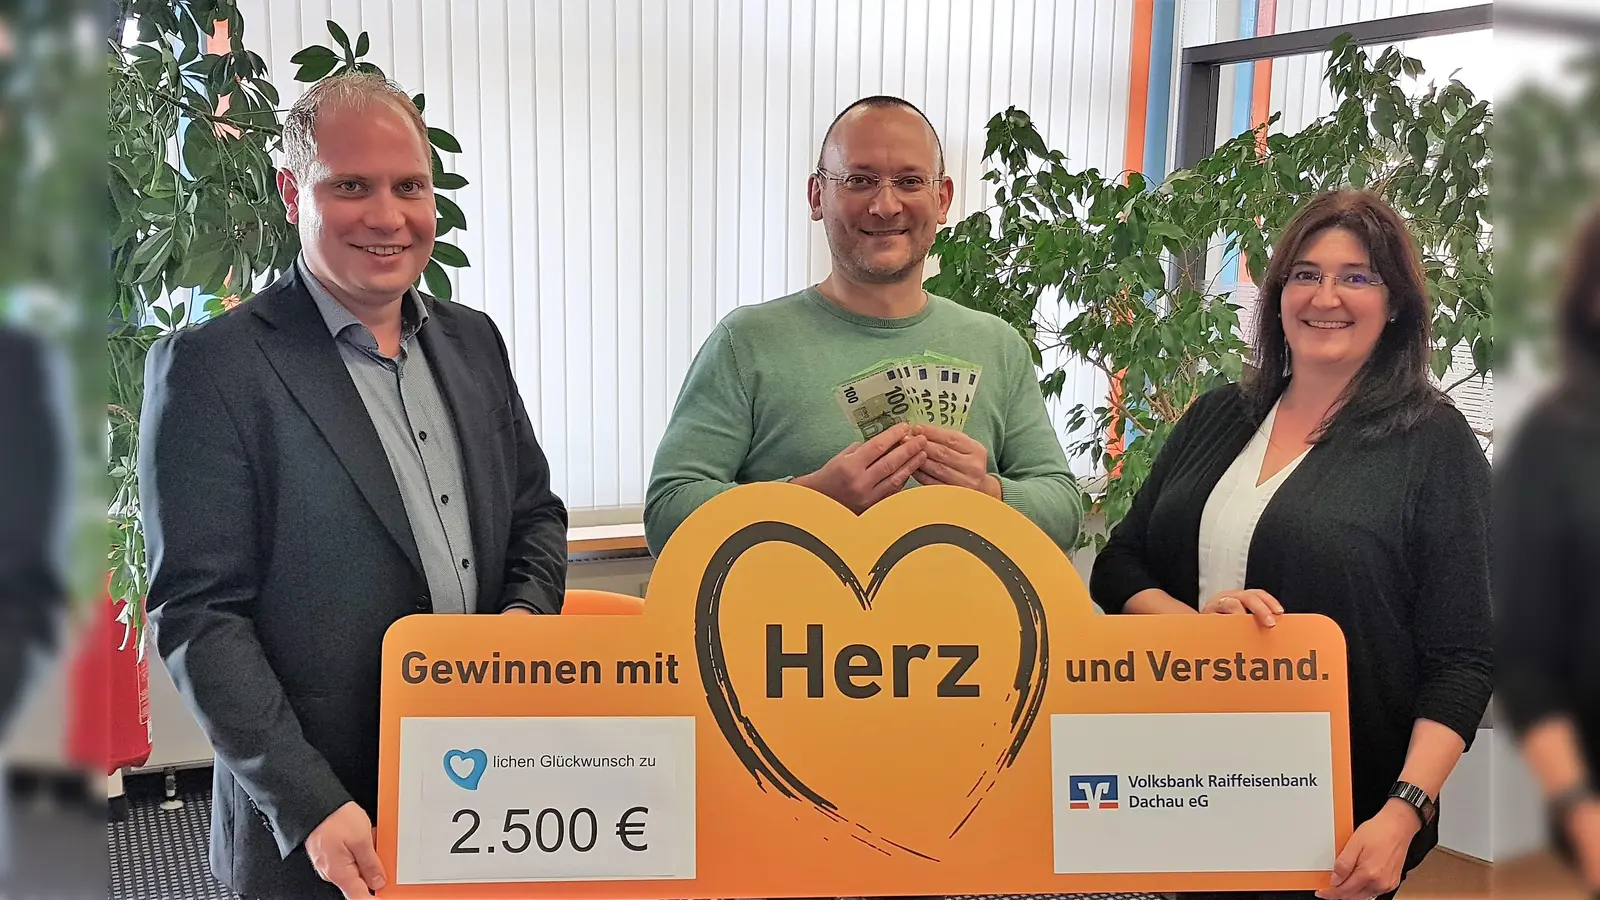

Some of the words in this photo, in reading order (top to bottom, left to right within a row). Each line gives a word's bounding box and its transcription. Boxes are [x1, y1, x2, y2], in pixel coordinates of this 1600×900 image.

[843, 386, 859, 404] 100
[884, 385, 909, 415] 100
[401, 651, 602, 685] Gewinnen
[616, 652, 680, 685] mit
[765, 623, 981, 699] Herz
[1065, 650, 1136, 683] und
[1145, 649, 1330, 682] Verstand.
[493, 755, 535, 768] lichen
[540, 754, 635, 768] Glückwunsch
[639, 757, 657, 768] zu
[1127, 773, 1204, 789] Volksbank
[1207, 772, 1319, 788] Raiffeisenbank
[1128, 793, 1185, 809] Dachau
[1188, 794, 1209, 808] eG
[450, 807, 598, 854] 2.500
[615, 806, 650, 852] €
